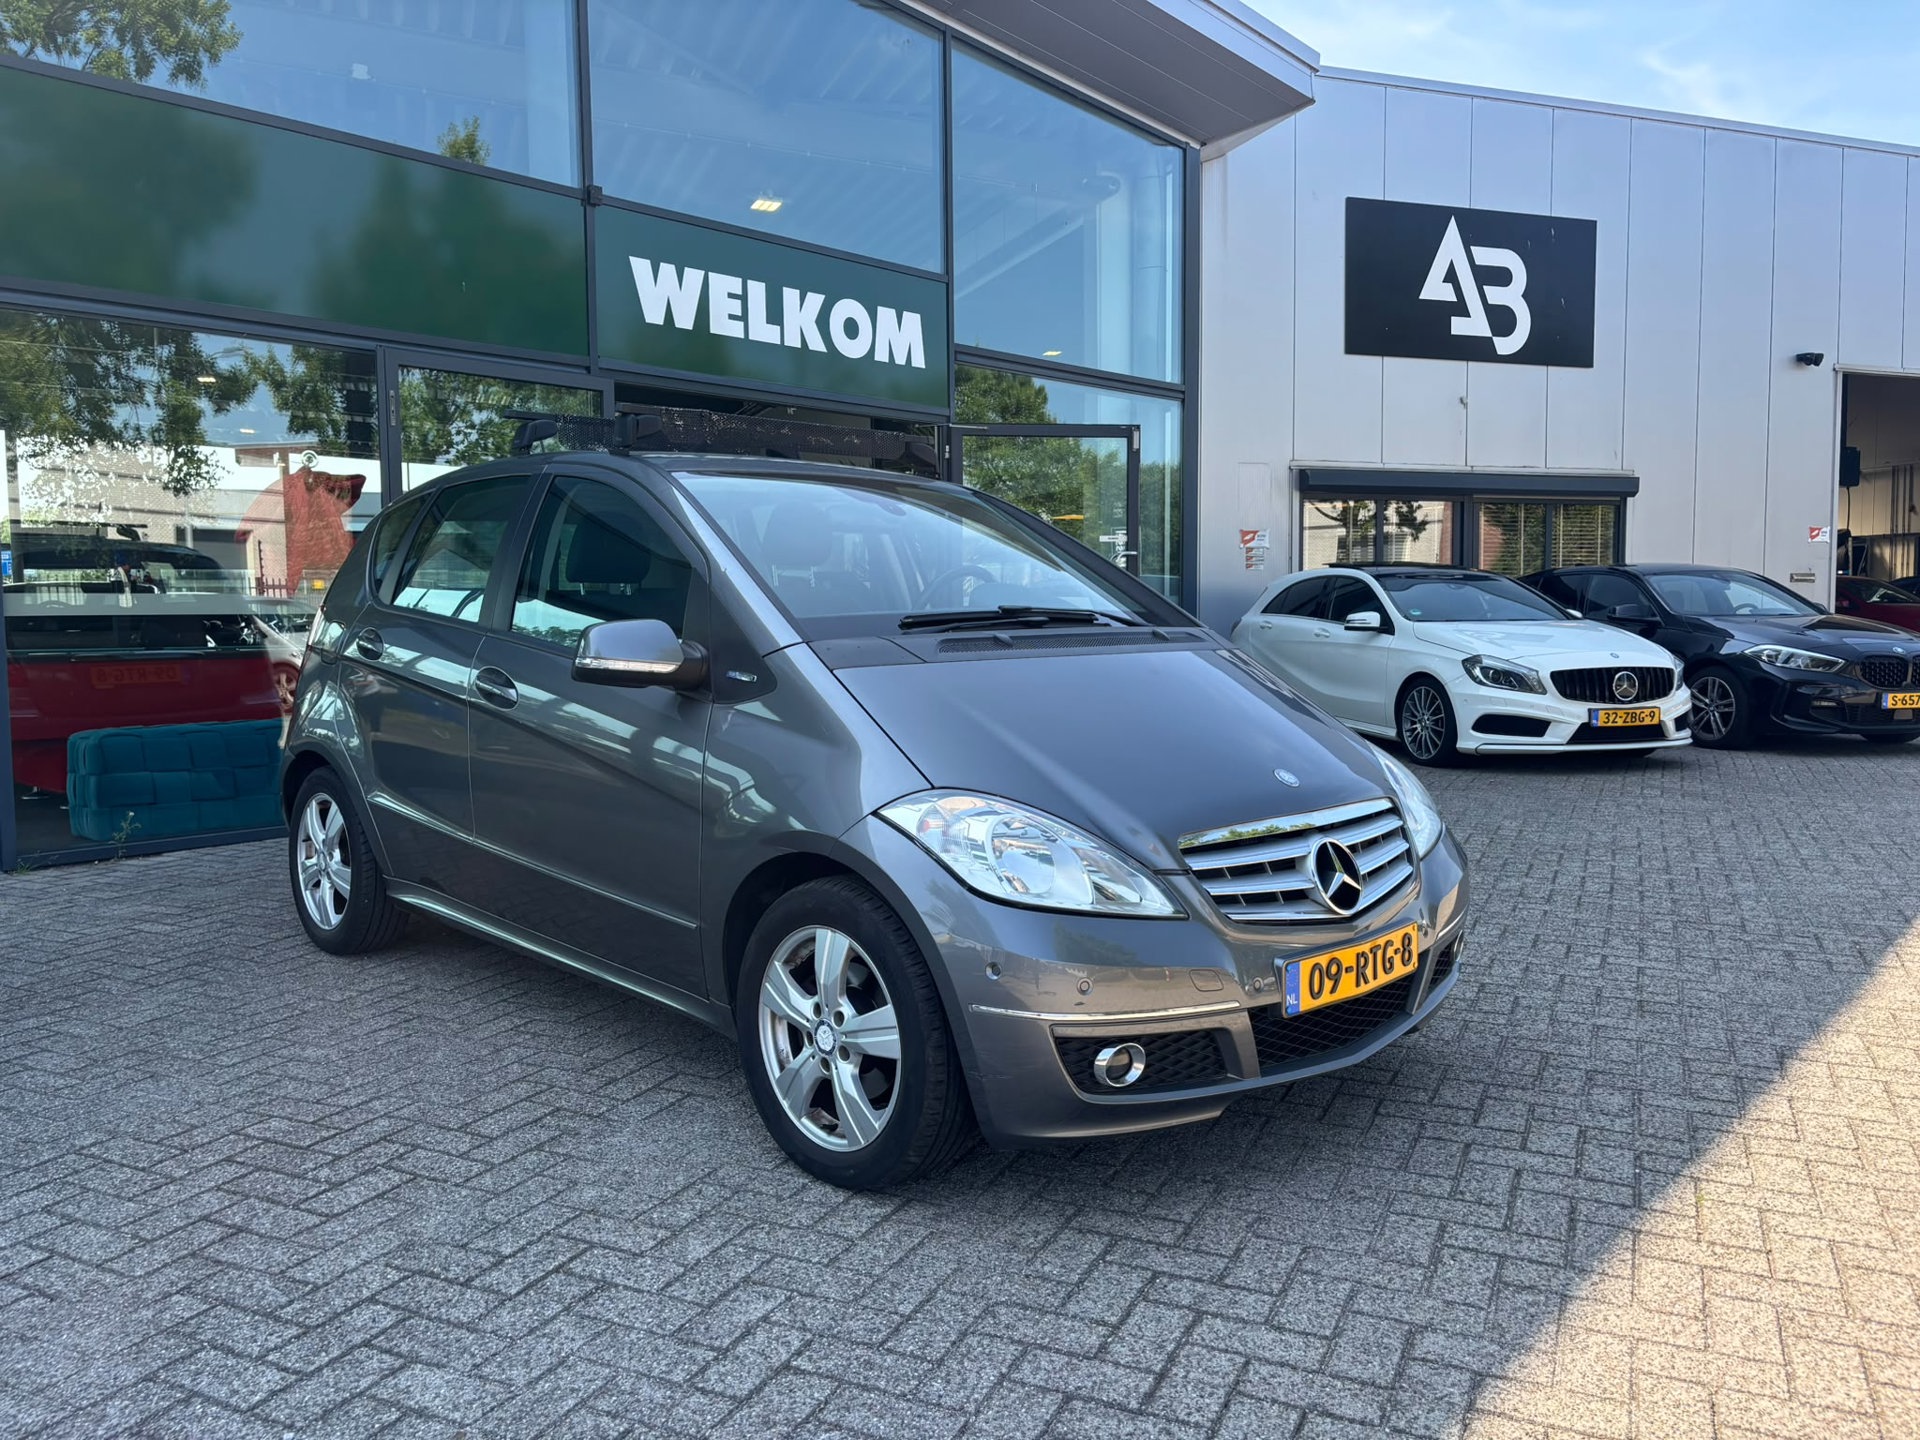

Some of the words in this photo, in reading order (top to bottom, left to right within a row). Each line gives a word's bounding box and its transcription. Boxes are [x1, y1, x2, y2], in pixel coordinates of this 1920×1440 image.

[628, 255, 926, 369] WELKOM
[1419, 215, 1531, 355] AB
[1603, 710, 1656, 724] 32-ZBG-9
[1286, 994, 1298, 1006] NL
[1309, 932, 1413, 1000] 09-RTG-8
